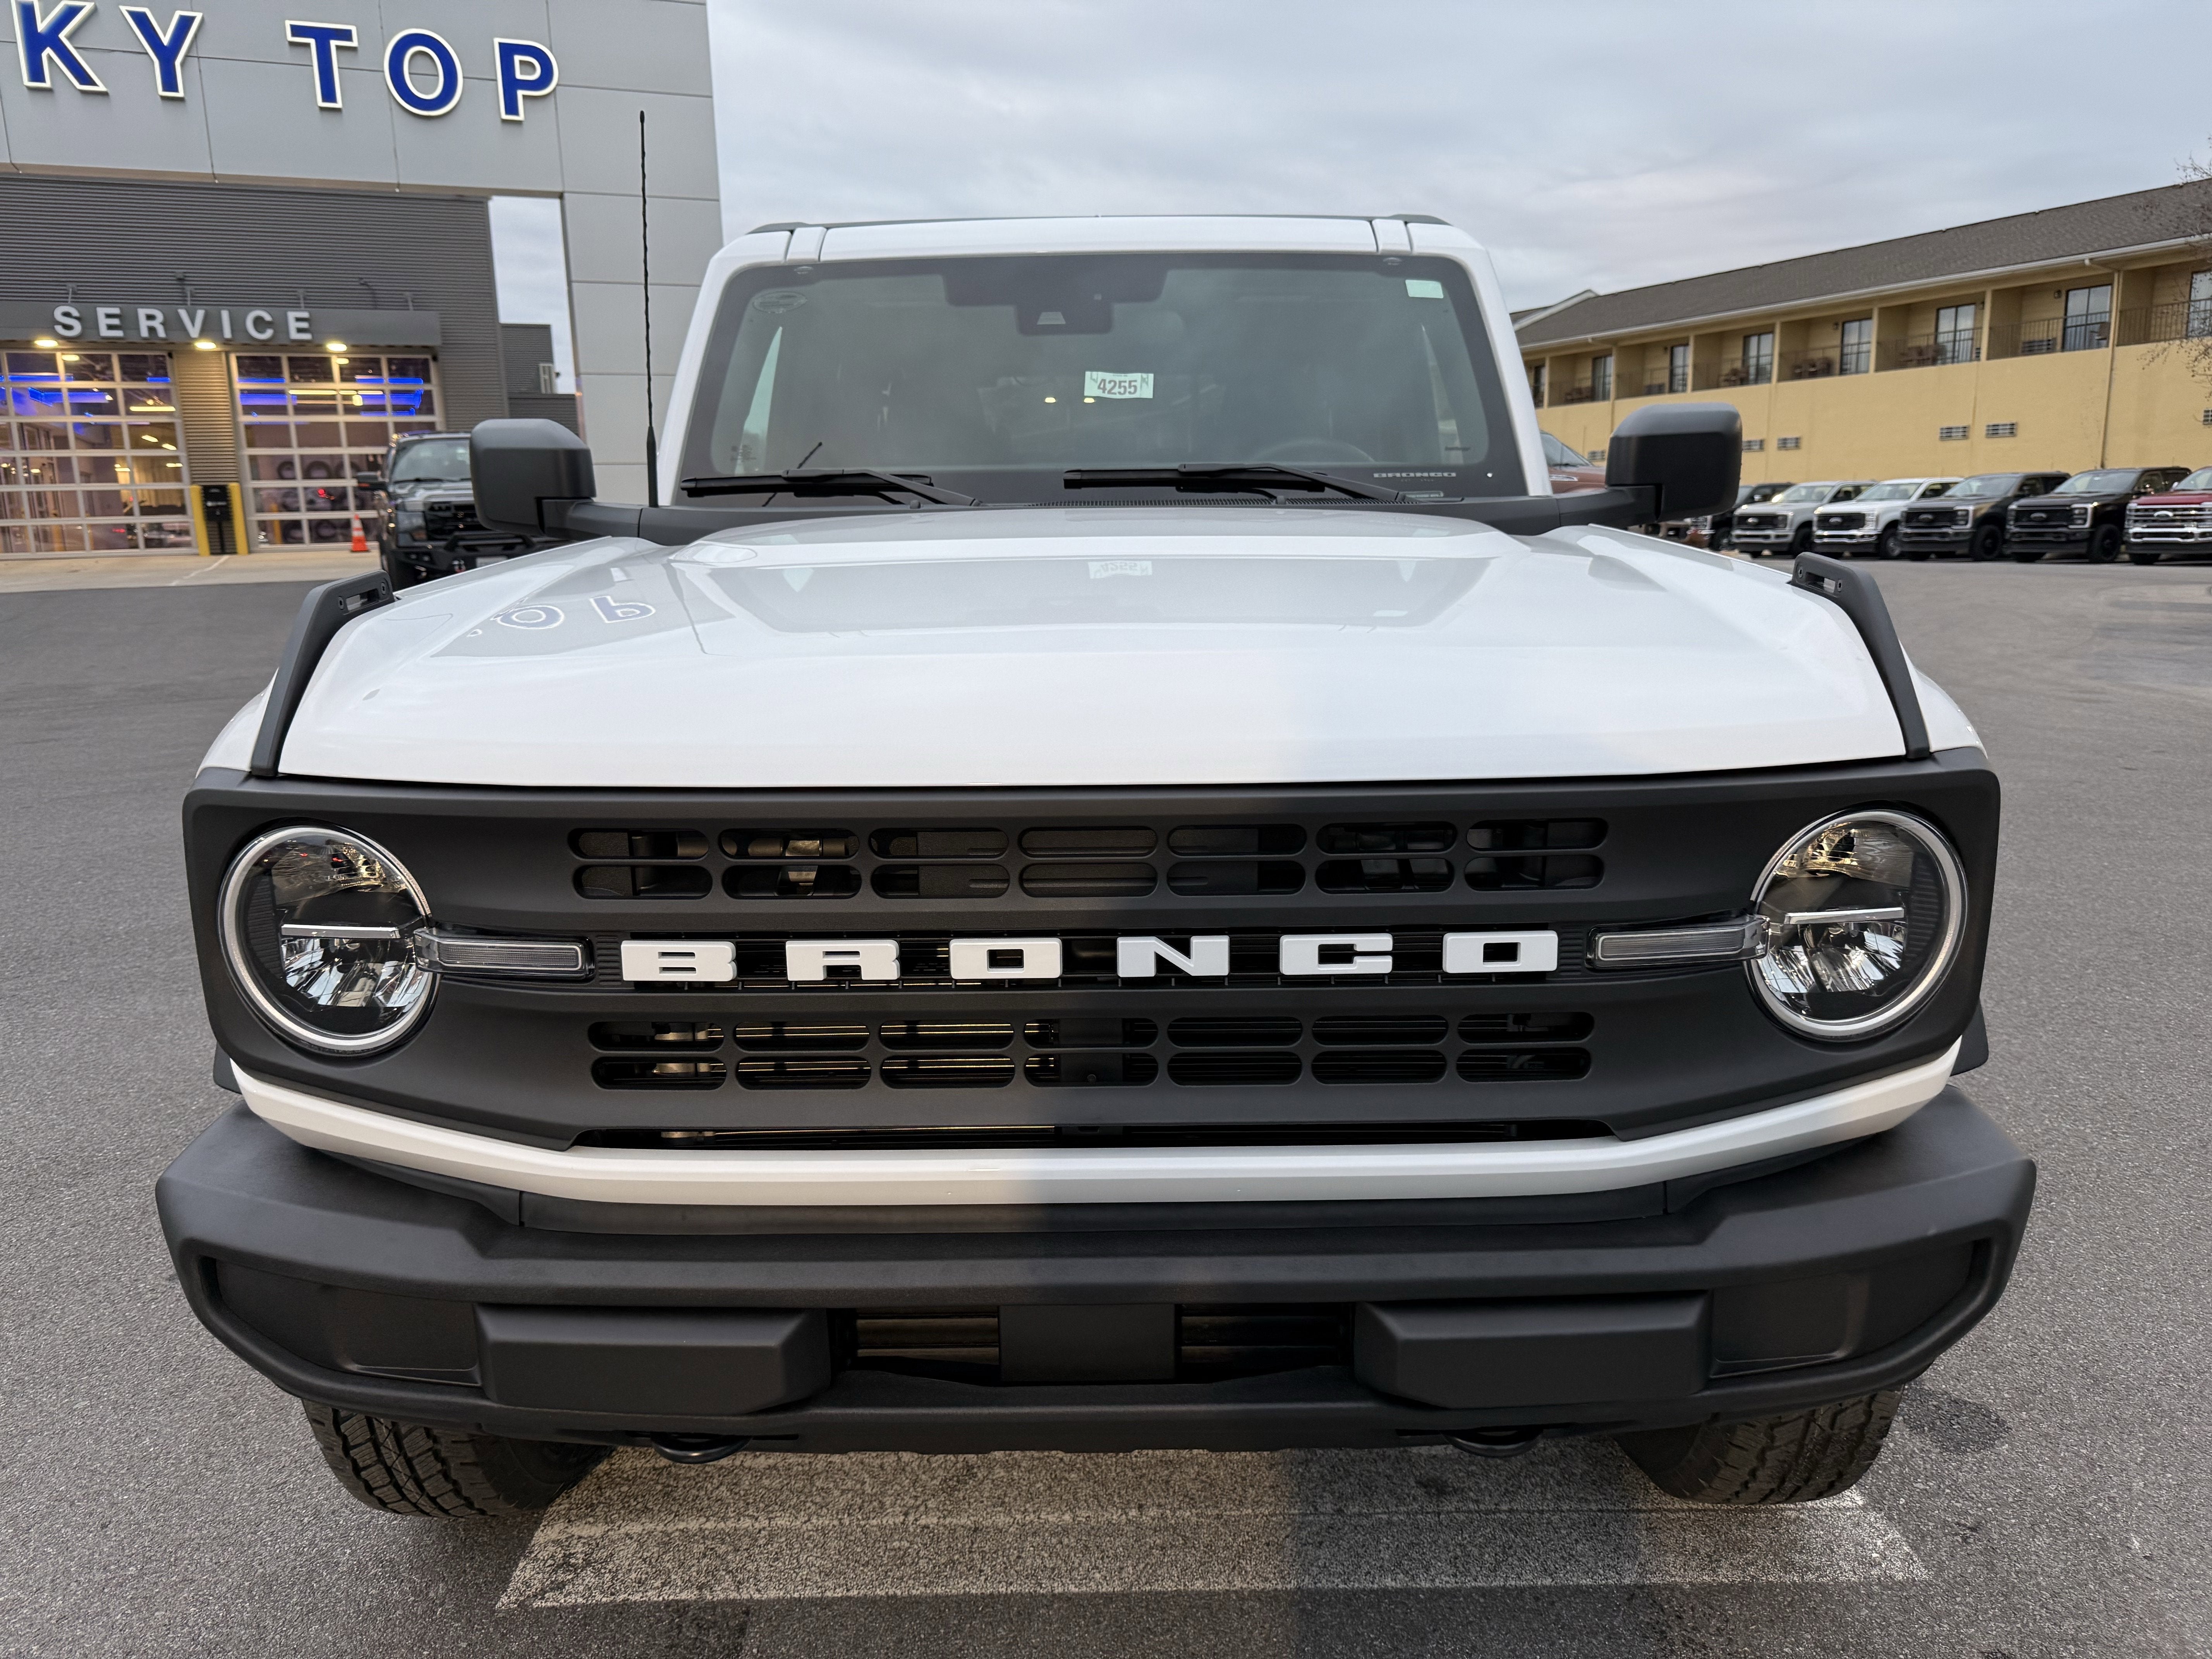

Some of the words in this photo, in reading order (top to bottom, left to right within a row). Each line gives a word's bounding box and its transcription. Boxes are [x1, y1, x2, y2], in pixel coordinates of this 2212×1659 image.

[11, 0, 203, 97] KY
[285, 19, 558, 121] TOP
[53, 305, 313, 340] SERVICE
[1097, 379, 1138, 395] 4255
[621, 931, 1558, 981] BRONCO
